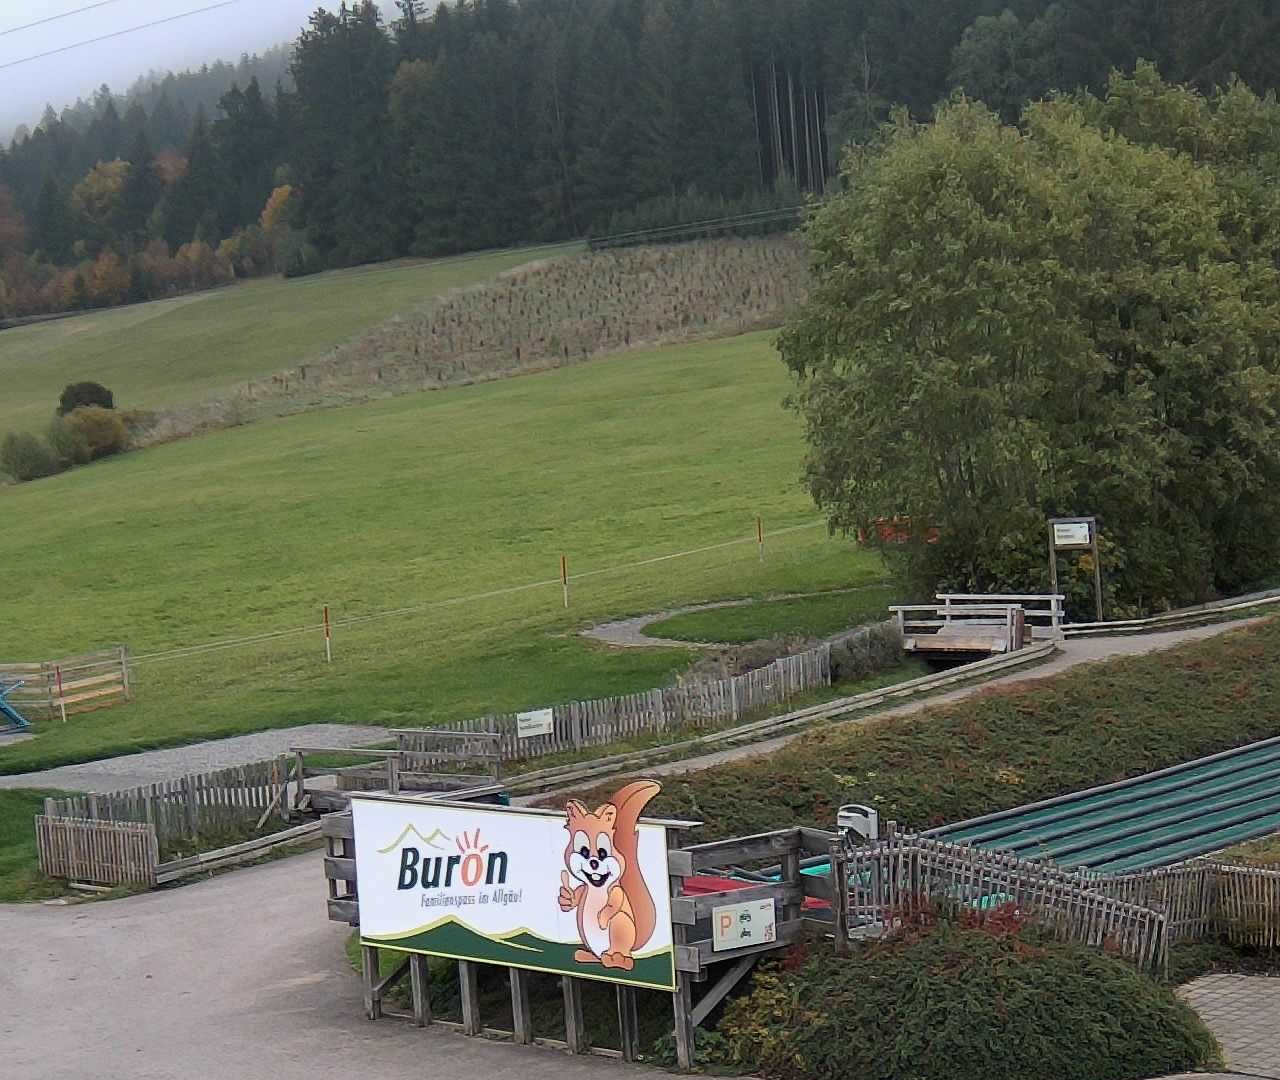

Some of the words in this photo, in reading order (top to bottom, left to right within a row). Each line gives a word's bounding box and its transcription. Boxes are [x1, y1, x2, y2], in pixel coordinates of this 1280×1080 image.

[397, 847, 508, 890] Buron
[479, 891, 489, 905] im
[492, 888, 523, 906] Allgäu!
[720, 915, 732, 937] P
